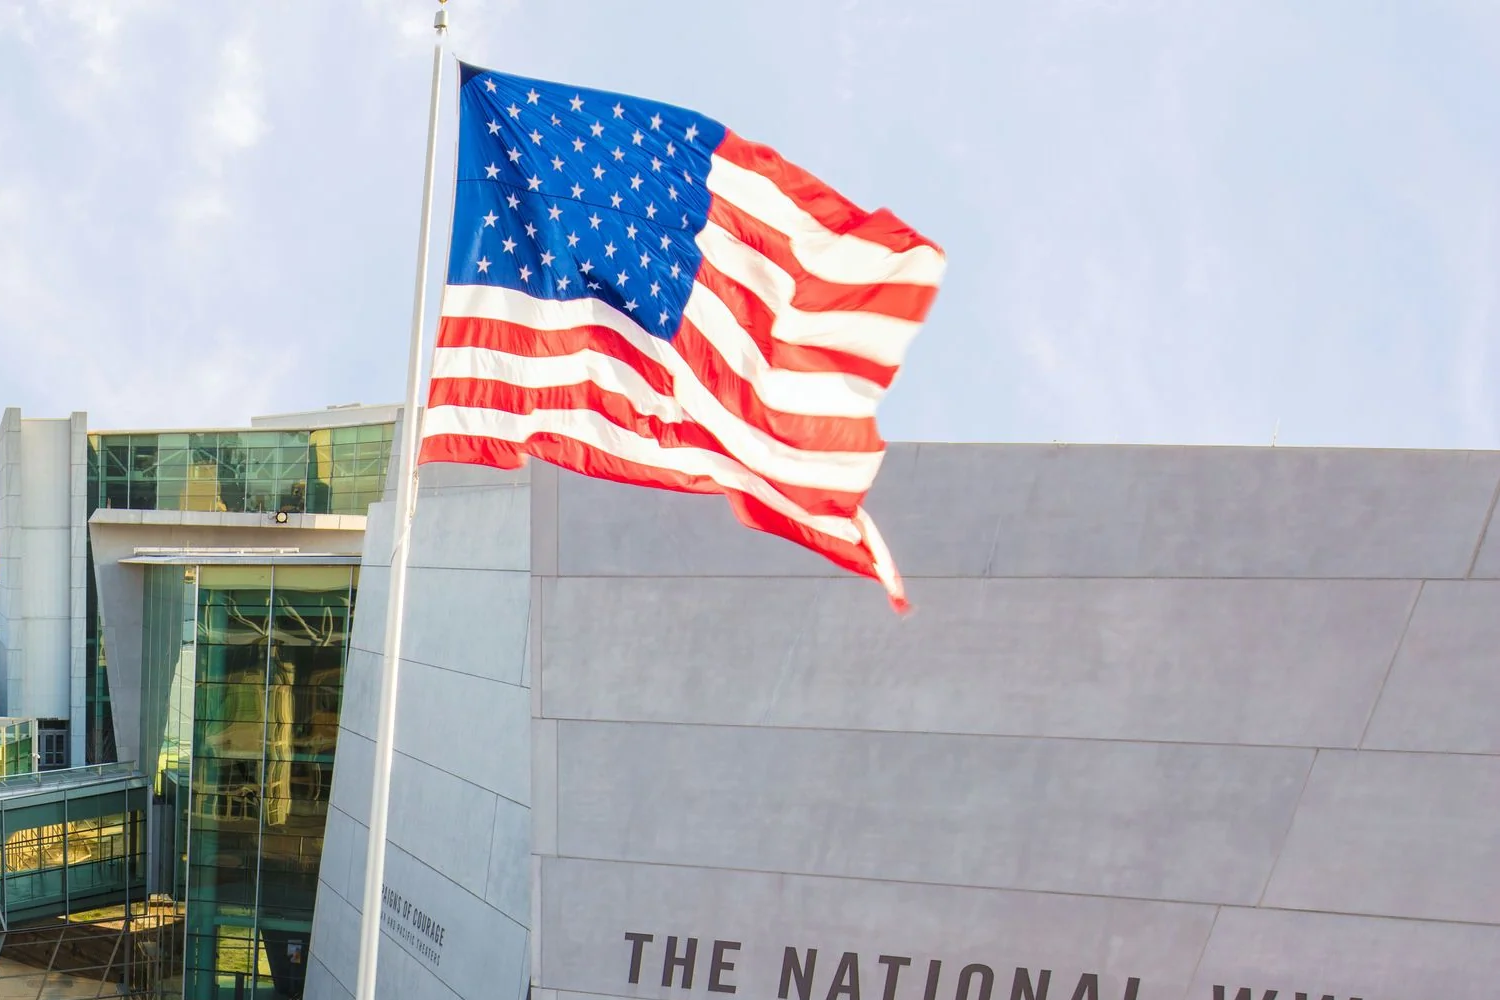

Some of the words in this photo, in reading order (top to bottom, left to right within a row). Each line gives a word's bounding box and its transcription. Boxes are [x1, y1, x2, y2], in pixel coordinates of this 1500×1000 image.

[402, 900, 412, 921] OF
[412, 908, 445, 947] COURAGE
[624, 931, 742, 994] THE
